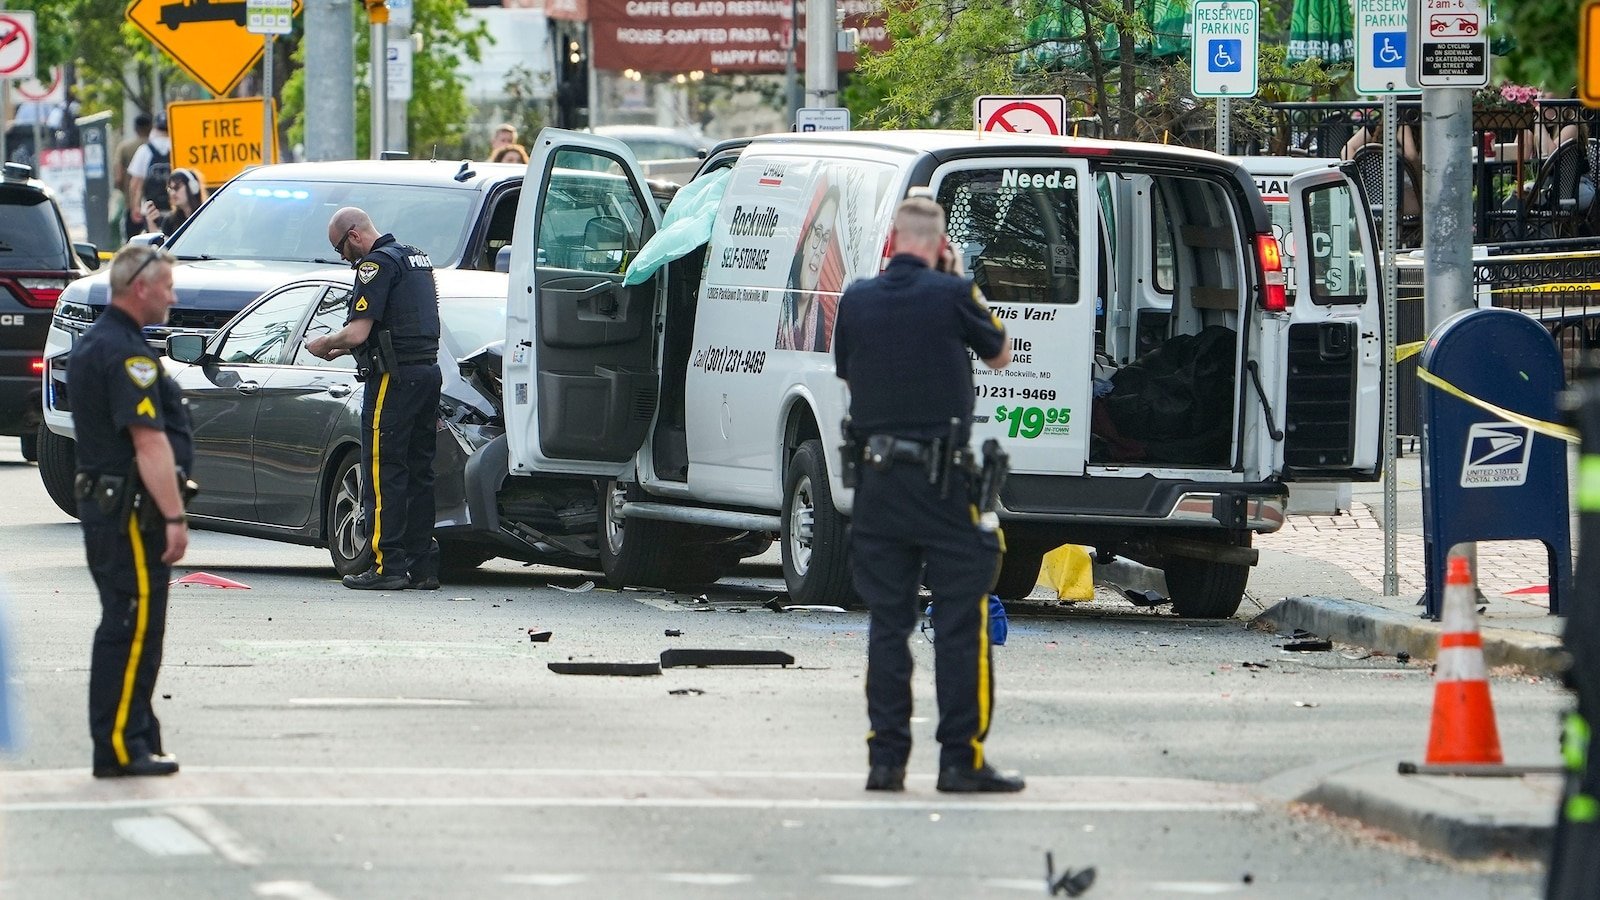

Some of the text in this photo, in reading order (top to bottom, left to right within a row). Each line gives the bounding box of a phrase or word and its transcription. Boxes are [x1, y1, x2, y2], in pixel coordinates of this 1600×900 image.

[671, 1, 726, 17] GELATO
[1360, 0, 1407, 12] RESERV
[1428, 0, 1434, 8] 2
[1436, 0, 1450, 8] am
[1198, 9, 1253, 21] RESERVED
[1364, 14, 1408, 27] PARKIN
[728, 27, 770, 42] PASTA
[1201, 22, 1250, 35] PARKING
[711, 50, 756, 65] HAPPY
[202, 118, 243, 138] FIRE
[188, 143, 262, 164] STATION
[1001, 169, 1077, 190] Need a
[729, 205, 779, 238] Rockville
[721, 247, 770, 270] SELF-STORAGE
[0, 315, 24, 326] CE
[1024, 307, 1057, 321] Van!
[994, 368, 1004, 377] Dr,
[1005, 370, 1038, 379] Rockville,
[990, 386, 1057, 401] 231-9469
